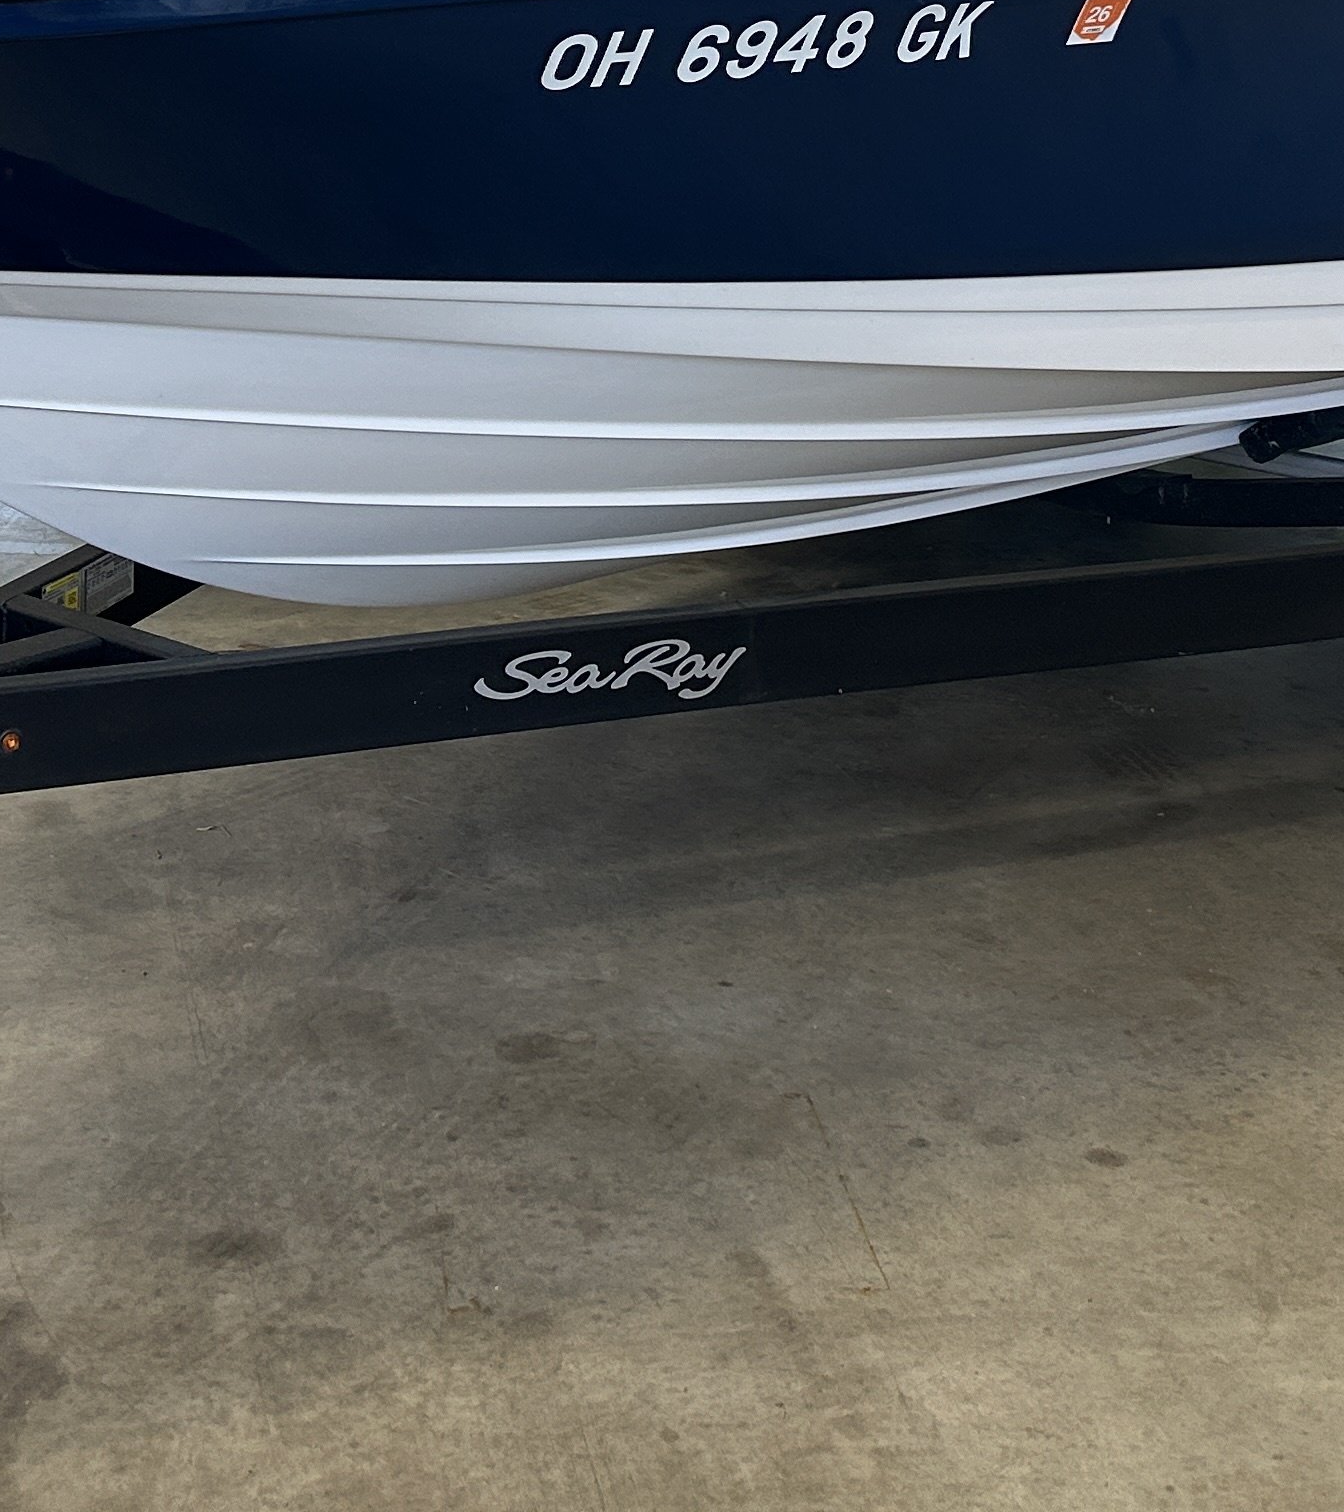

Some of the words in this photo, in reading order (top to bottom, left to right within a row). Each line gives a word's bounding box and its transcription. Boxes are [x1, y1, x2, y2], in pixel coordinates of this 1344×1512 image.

[1084, 4, 1114, 24] 26
[540, 28, 655, 91] OH
[676, 10, 874, 84] 6948
[896, 0, 995, 64] GK
[474, 649, 616, 700] Sea
[610, 639, 747, 700] Ray
